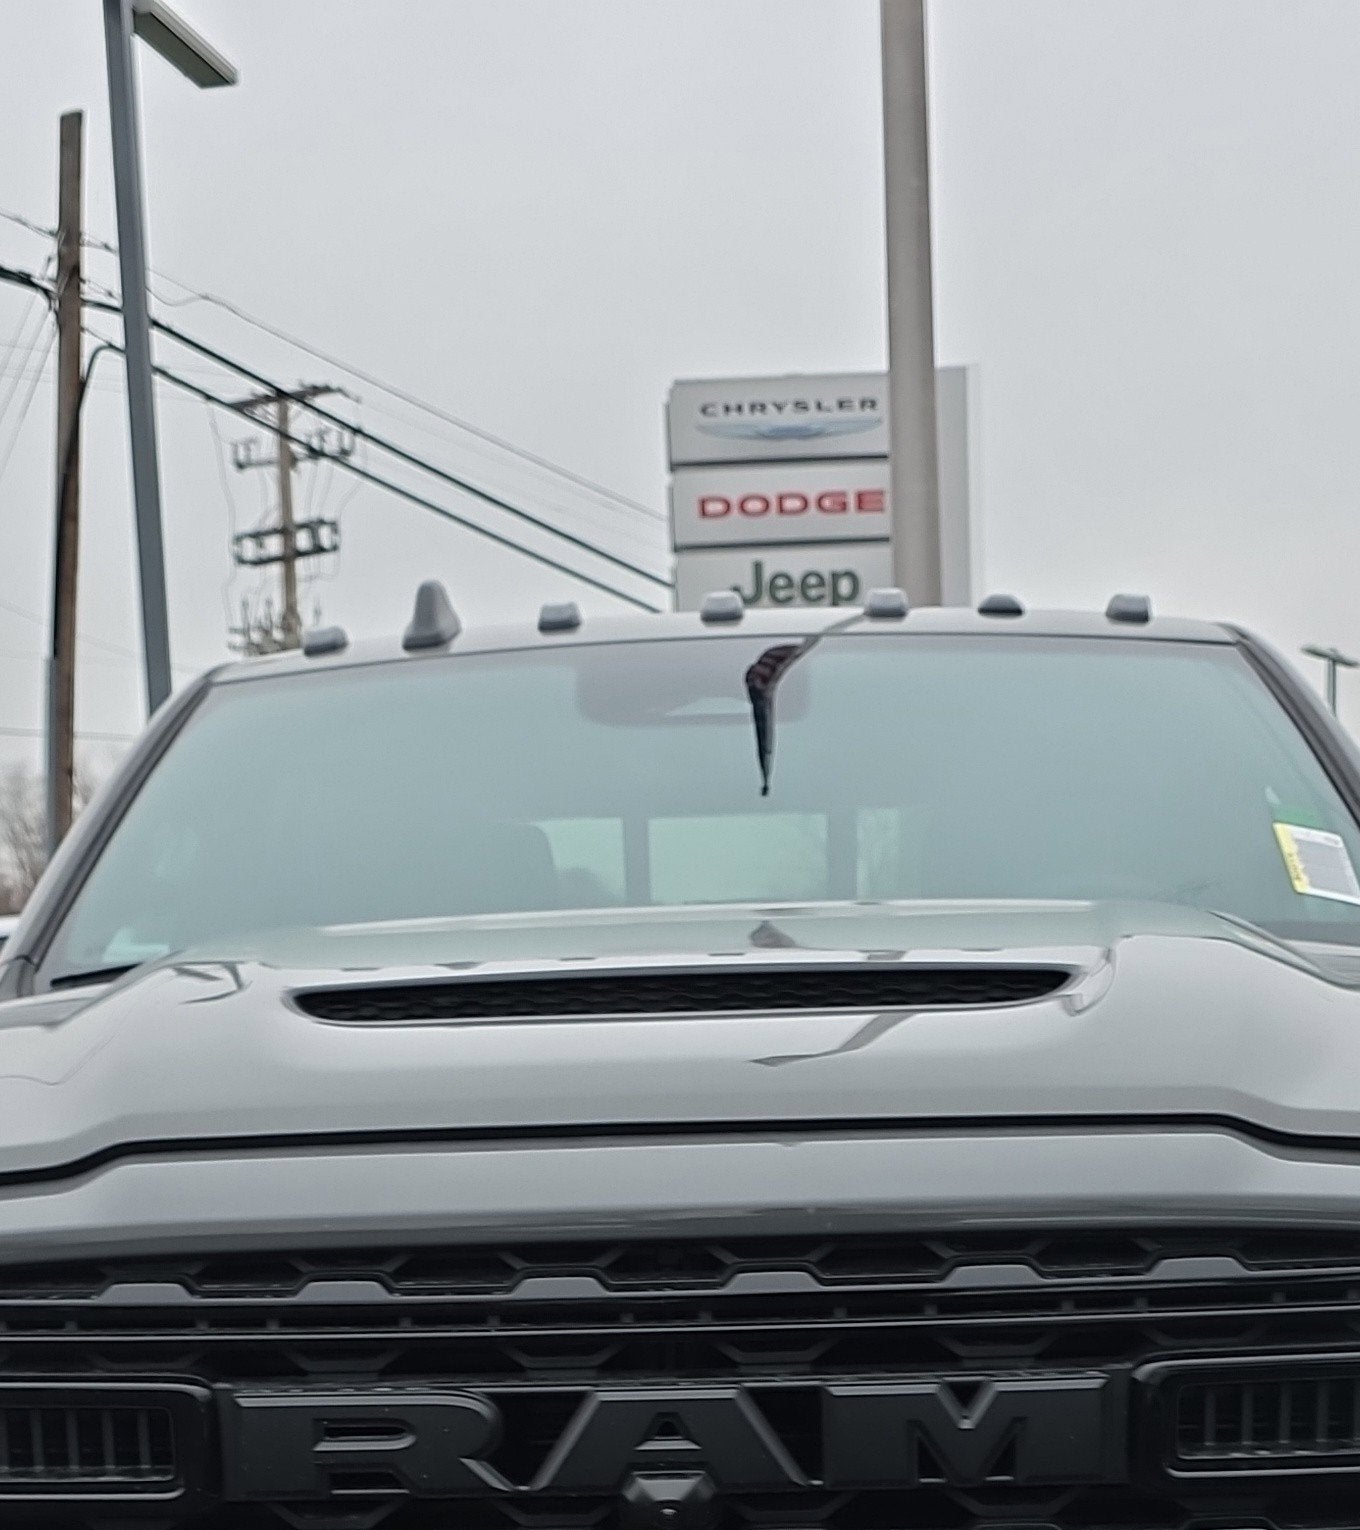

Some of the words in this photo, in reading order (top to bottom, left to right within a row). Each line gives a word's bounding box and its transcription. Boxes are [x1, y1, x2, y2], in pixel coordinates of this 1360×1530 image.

[699, 397, 879, 417] CHRYSLER
[699, 489, 884, 518] DODGE
[732, 560, 860, 606] Jeep
[232, 1382, 1112, 1496] RAM
